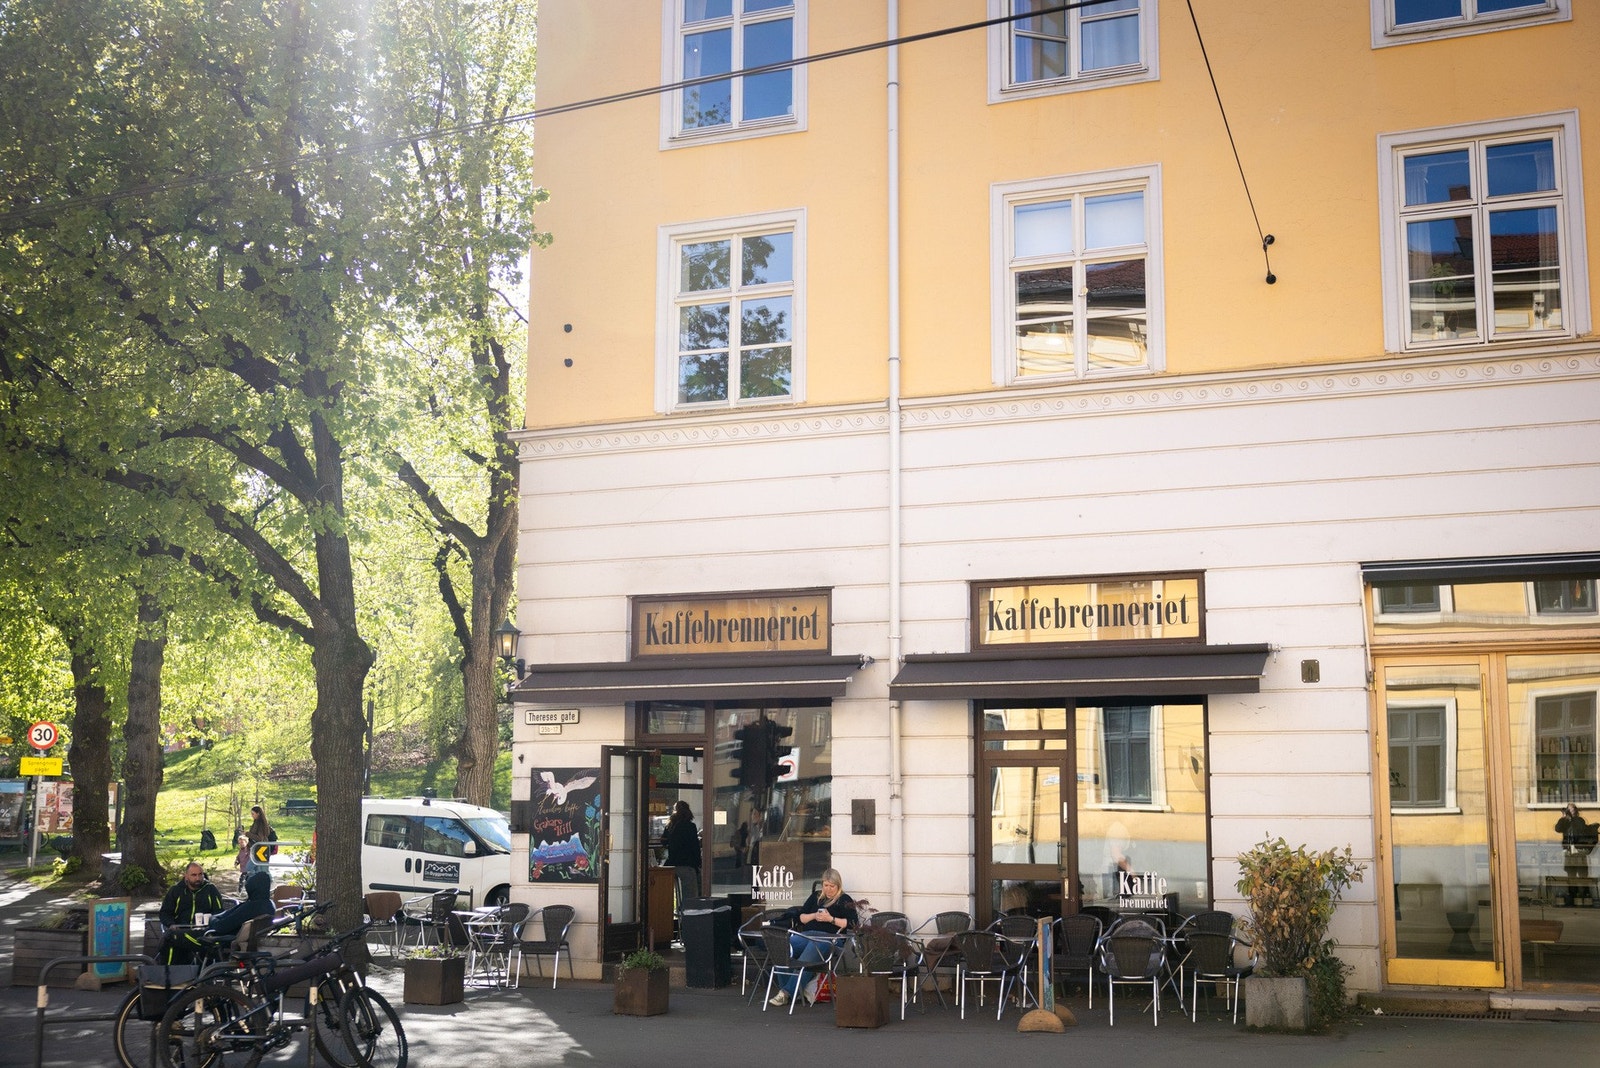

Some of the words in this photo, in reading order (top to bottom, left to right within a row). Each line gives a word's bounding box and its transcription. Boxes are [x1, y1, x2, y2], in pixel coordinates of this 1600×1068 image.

[988, 593, 1190, 632] Kaffebrenneriet
[645, 606, 822, 646] Kaffebrenneriet
[529, 712, 558, 721] Thereses
[560, 711, 576, 722] gate
[33, 728, 53, 742] 30
[751, 864, 794, 888] Kaffe
[1118, 870, 1168, 895] Kaffe
[751, 888, 793, 900] brenneriet
[1119, 895, 1168, 909] brenneriet
